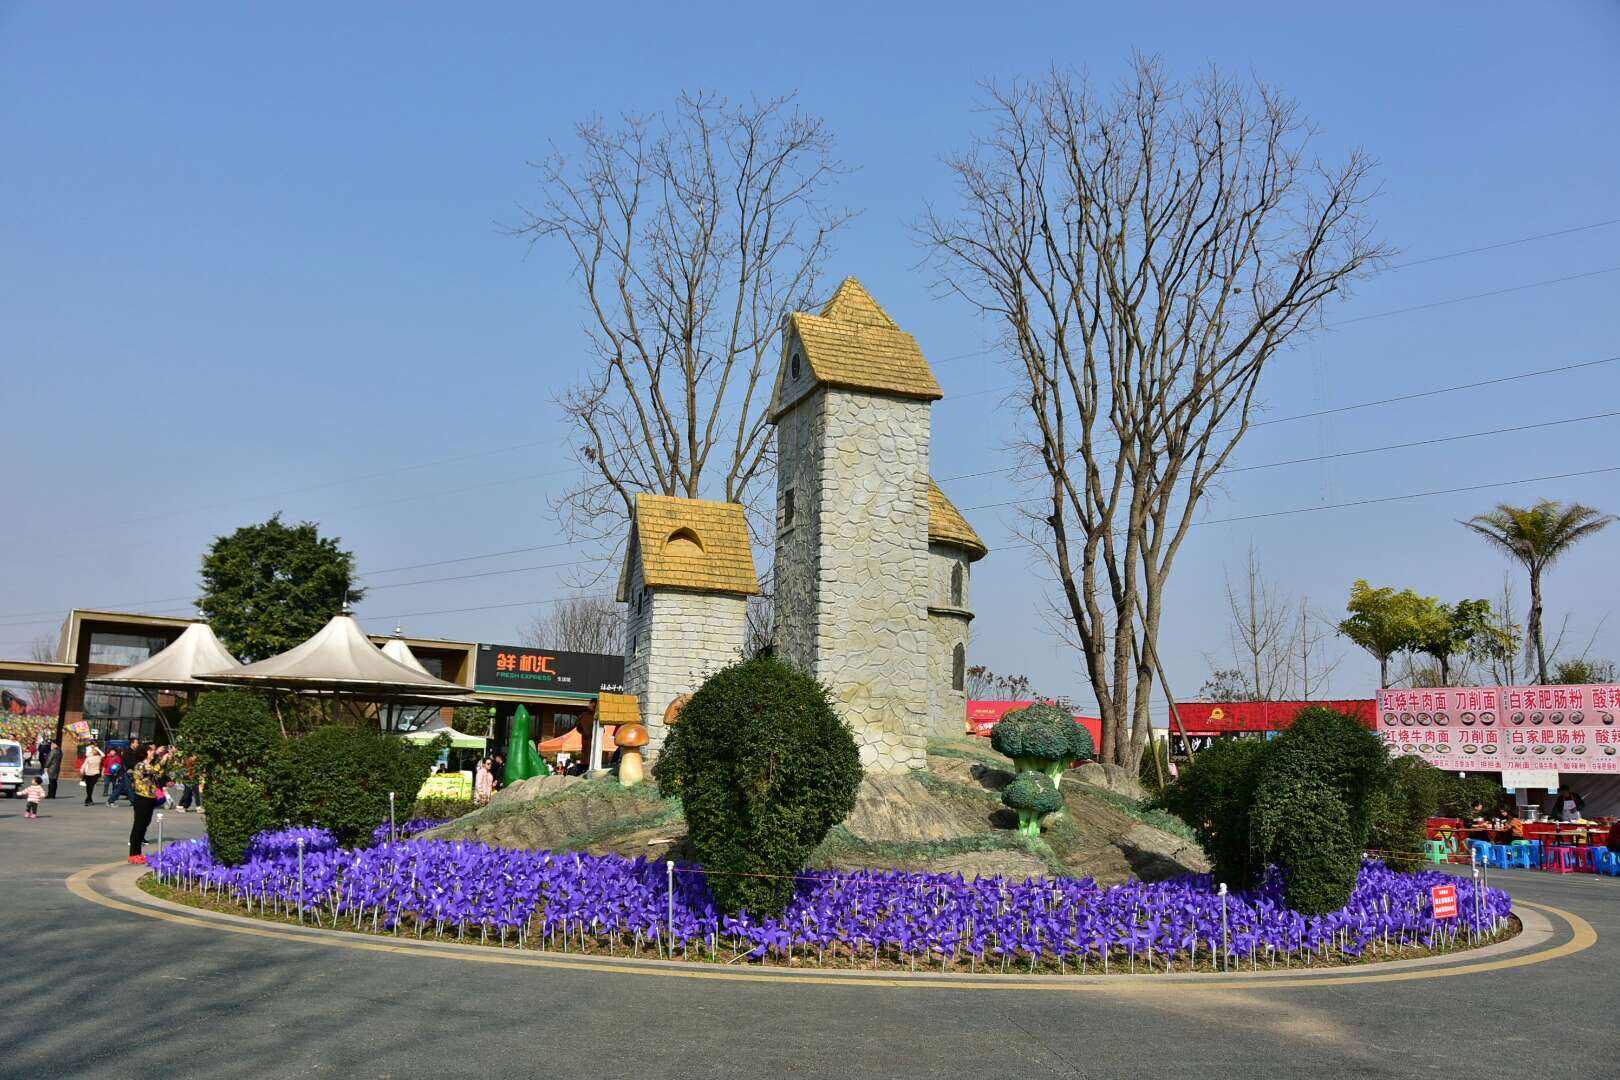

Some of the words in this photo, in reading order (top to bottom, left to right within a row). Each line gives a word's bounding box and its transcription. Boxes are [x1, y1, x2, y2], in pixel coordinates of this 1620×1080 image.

[496, 653, 557, 675] 鲜机汇
[496, 671, 520, 680] FRESH
[521, 673, 552, 682] EXPRESS
[1383, 690, 1447, 711] 红烧牛肉面
[1456, 690, 1496, 711] 刀削面
[1509, 688, 1583, 711] 白家肥肠粉
[1385, 729, 1449, 744] 红烧牛肉面
[1459, 729, 1499, 744] 刀削面
[1512, 729, 1586, 745] 白家肥肠粉
